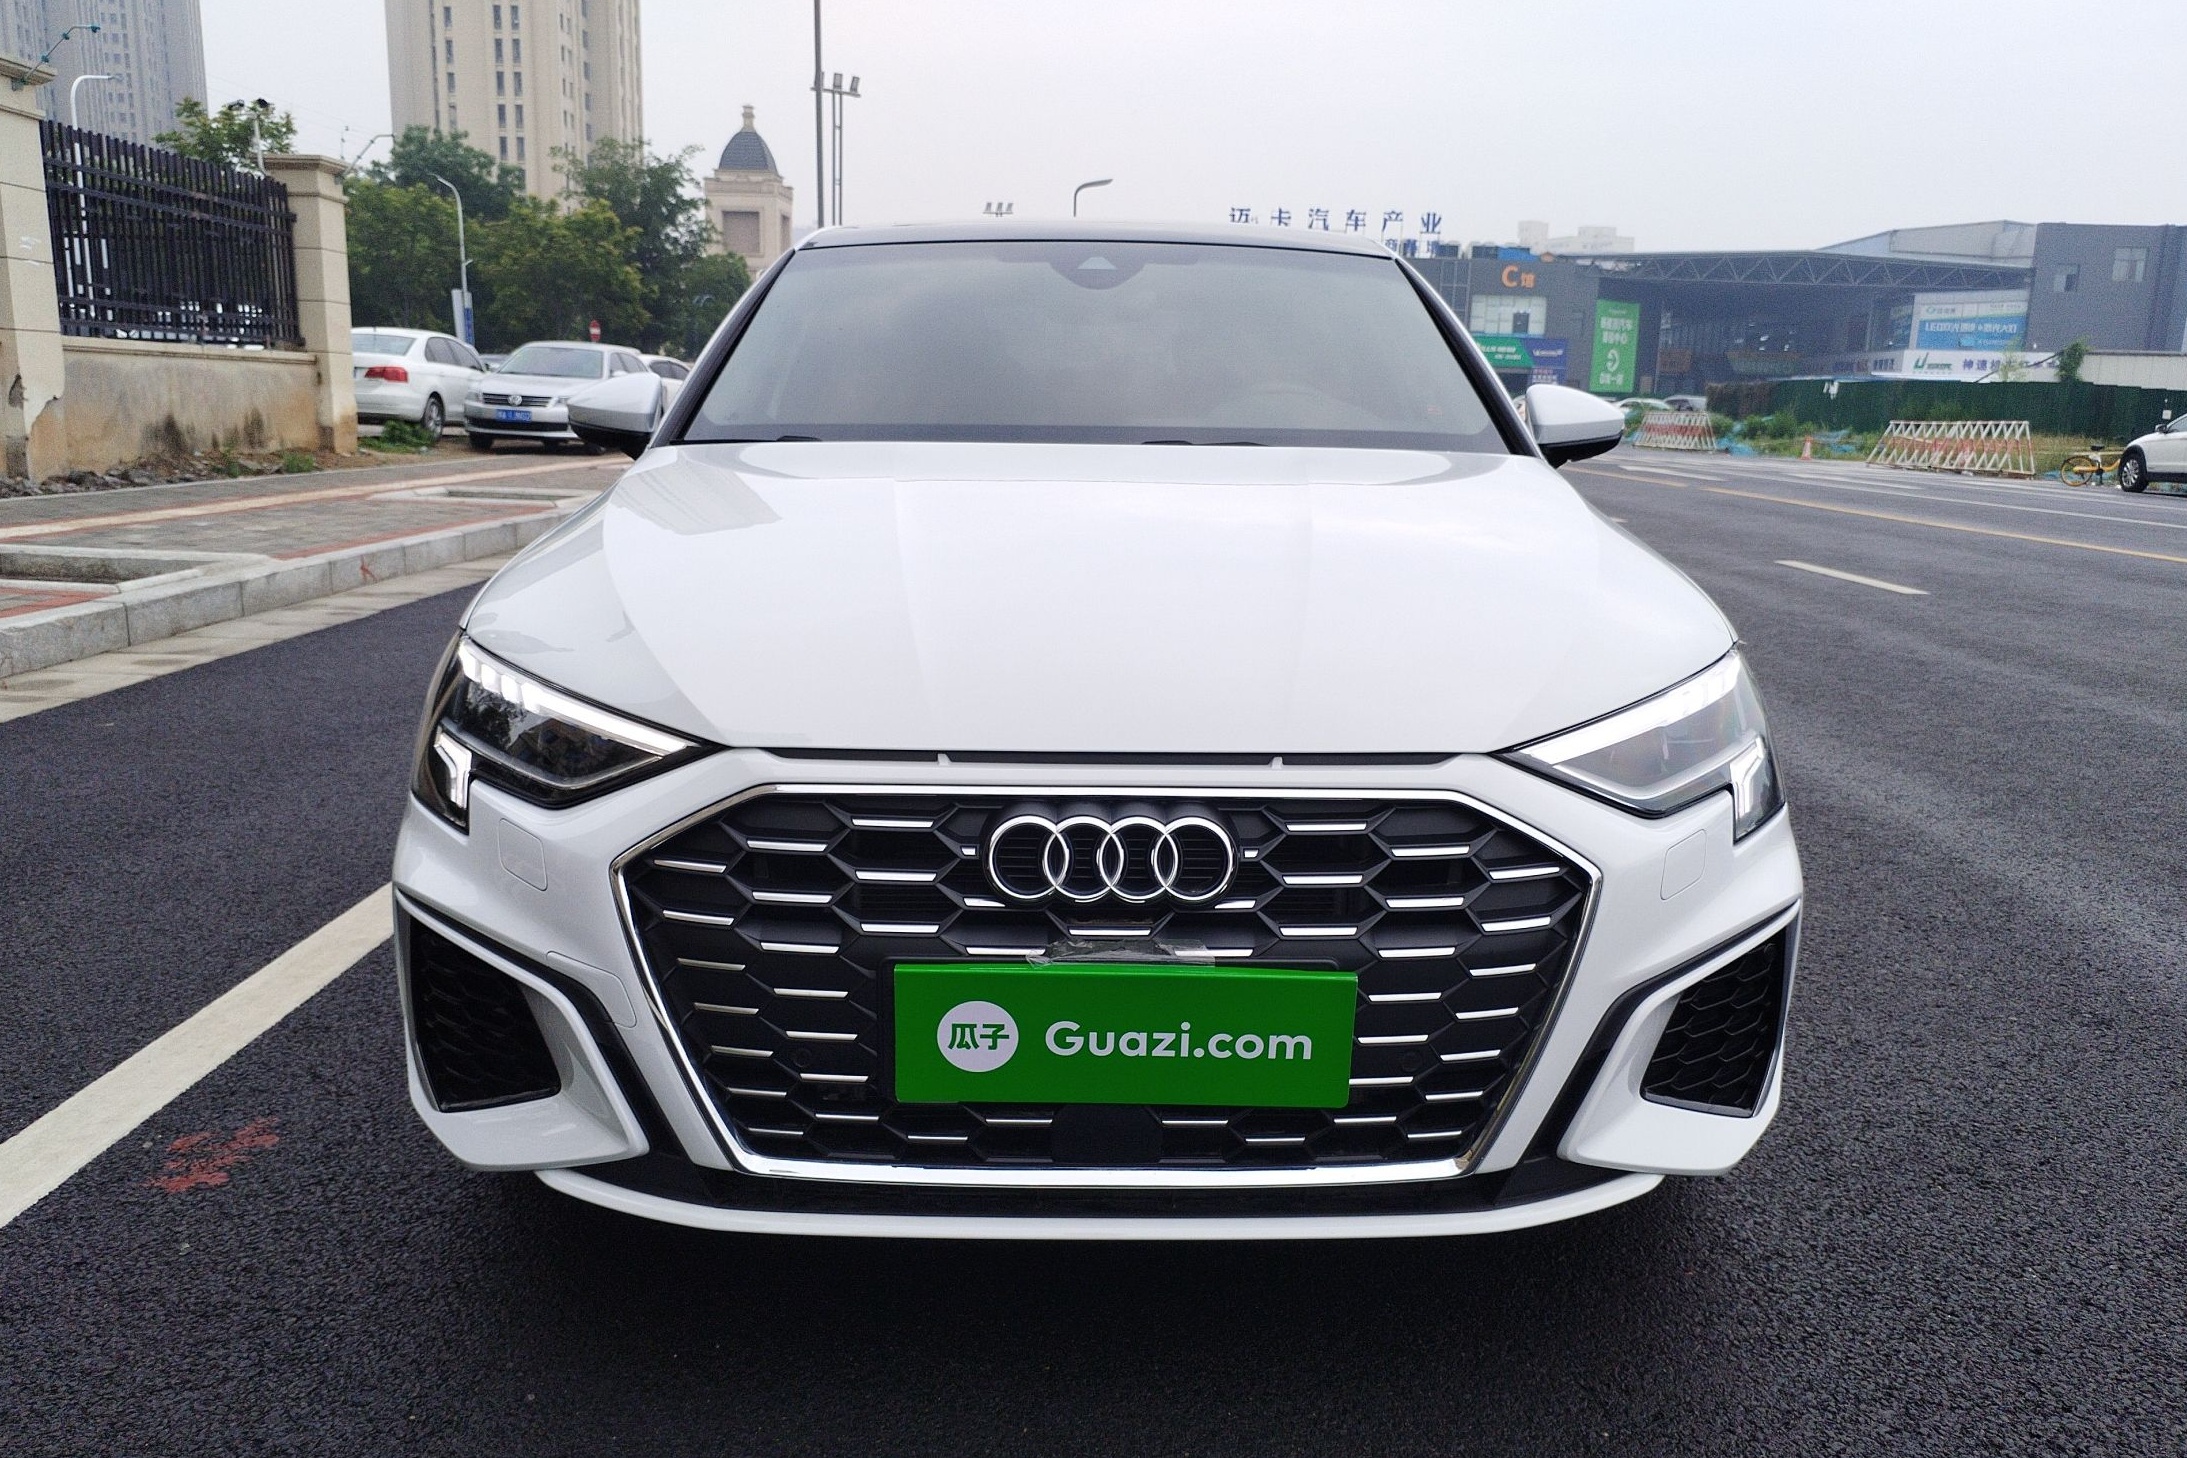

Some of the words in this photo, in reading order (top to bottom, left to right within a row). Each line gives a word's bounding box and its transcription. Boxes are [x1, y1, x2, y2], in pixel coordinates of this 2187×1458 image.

[1229, 207, 1442, 233] 迈卡汽车产业
[948, 1023, 1010, 1050] 瓜子
[1045, 1020, 1313, 1061] Guazi.com
